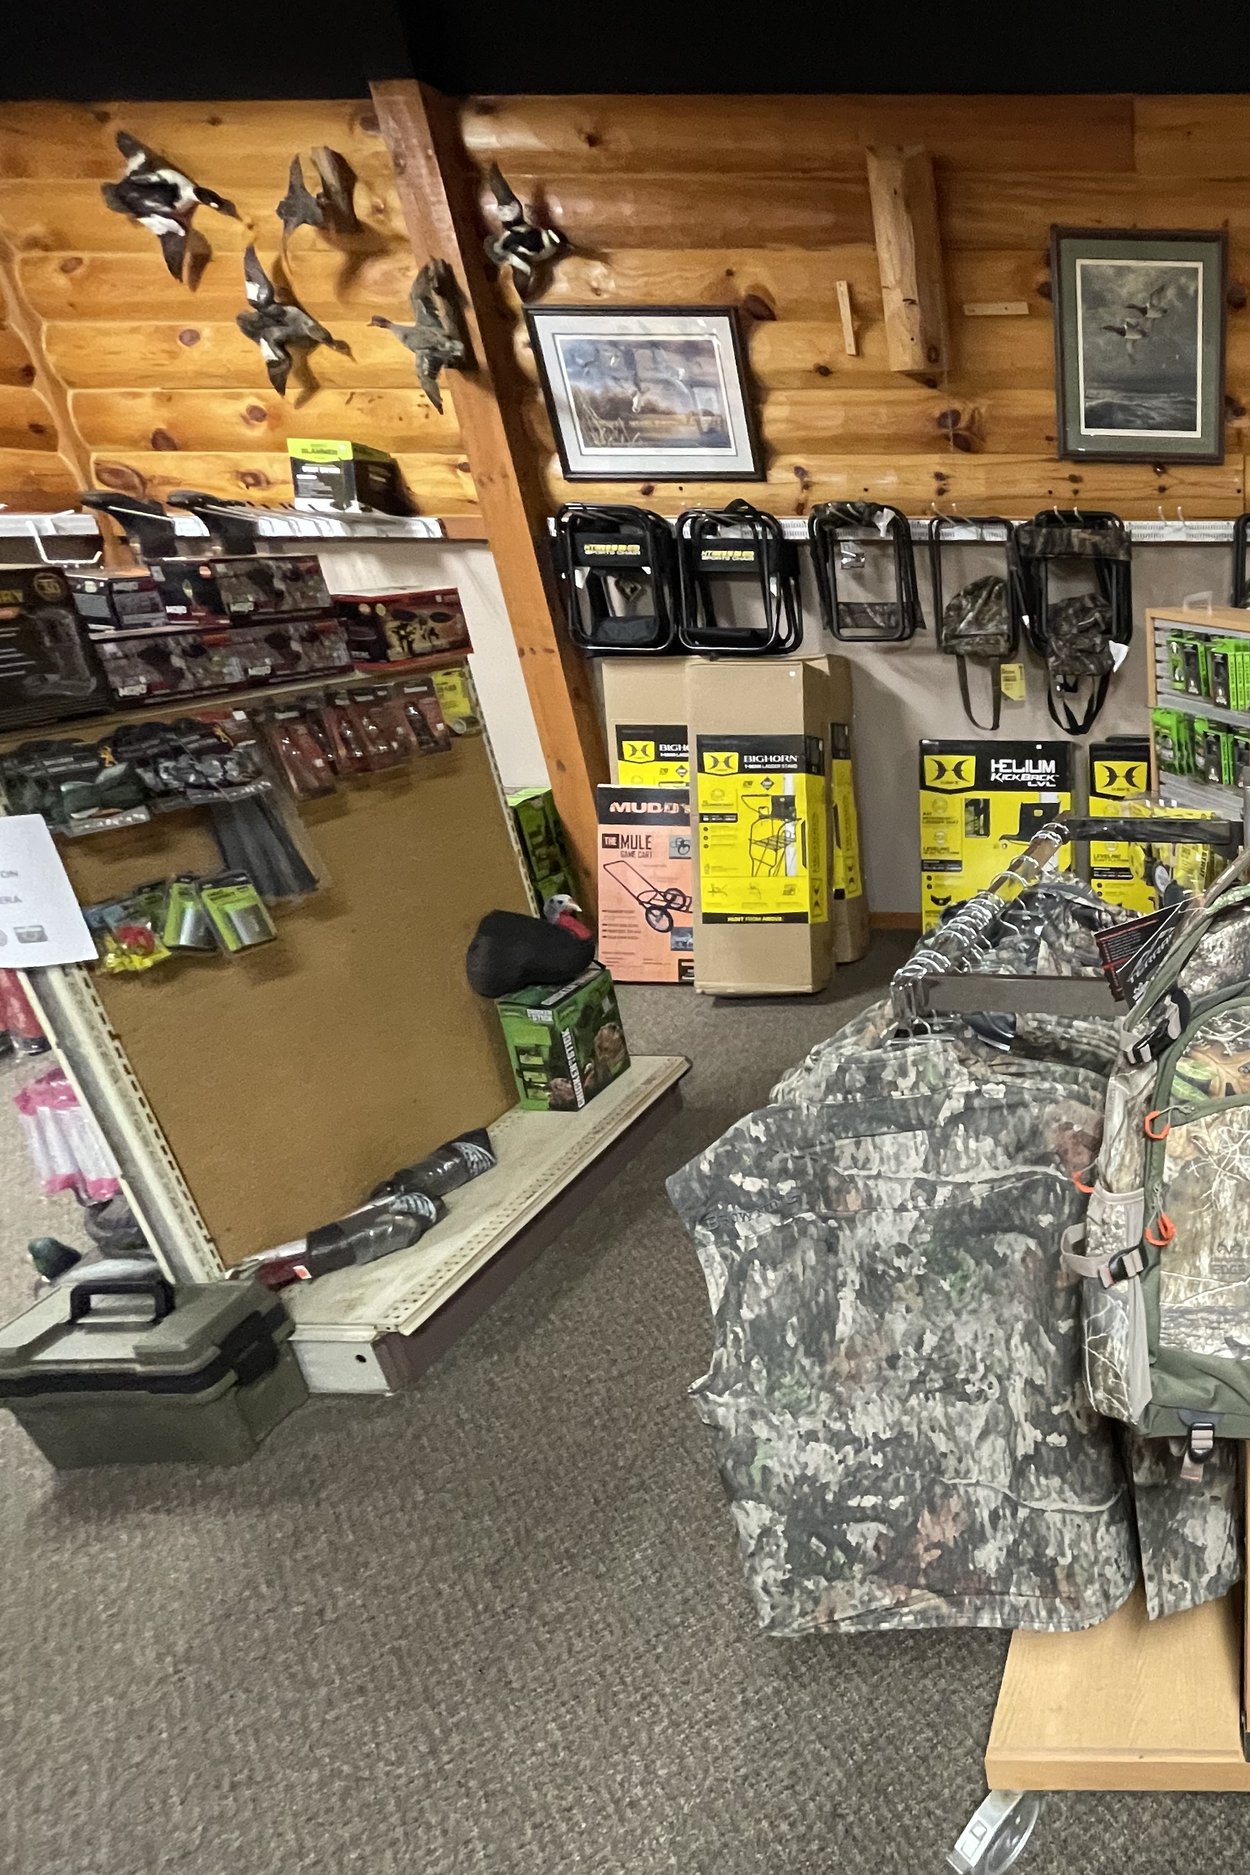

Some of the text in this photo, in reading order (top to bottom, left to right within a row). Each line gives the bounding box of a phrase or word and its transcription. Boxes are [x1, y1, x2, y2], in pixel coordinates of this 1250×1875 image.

[743, 755, 798, 763] BIGHORN
[990, 759, 1056, 773] HELIUM
[605, 835, 652, 850] THE MULE
